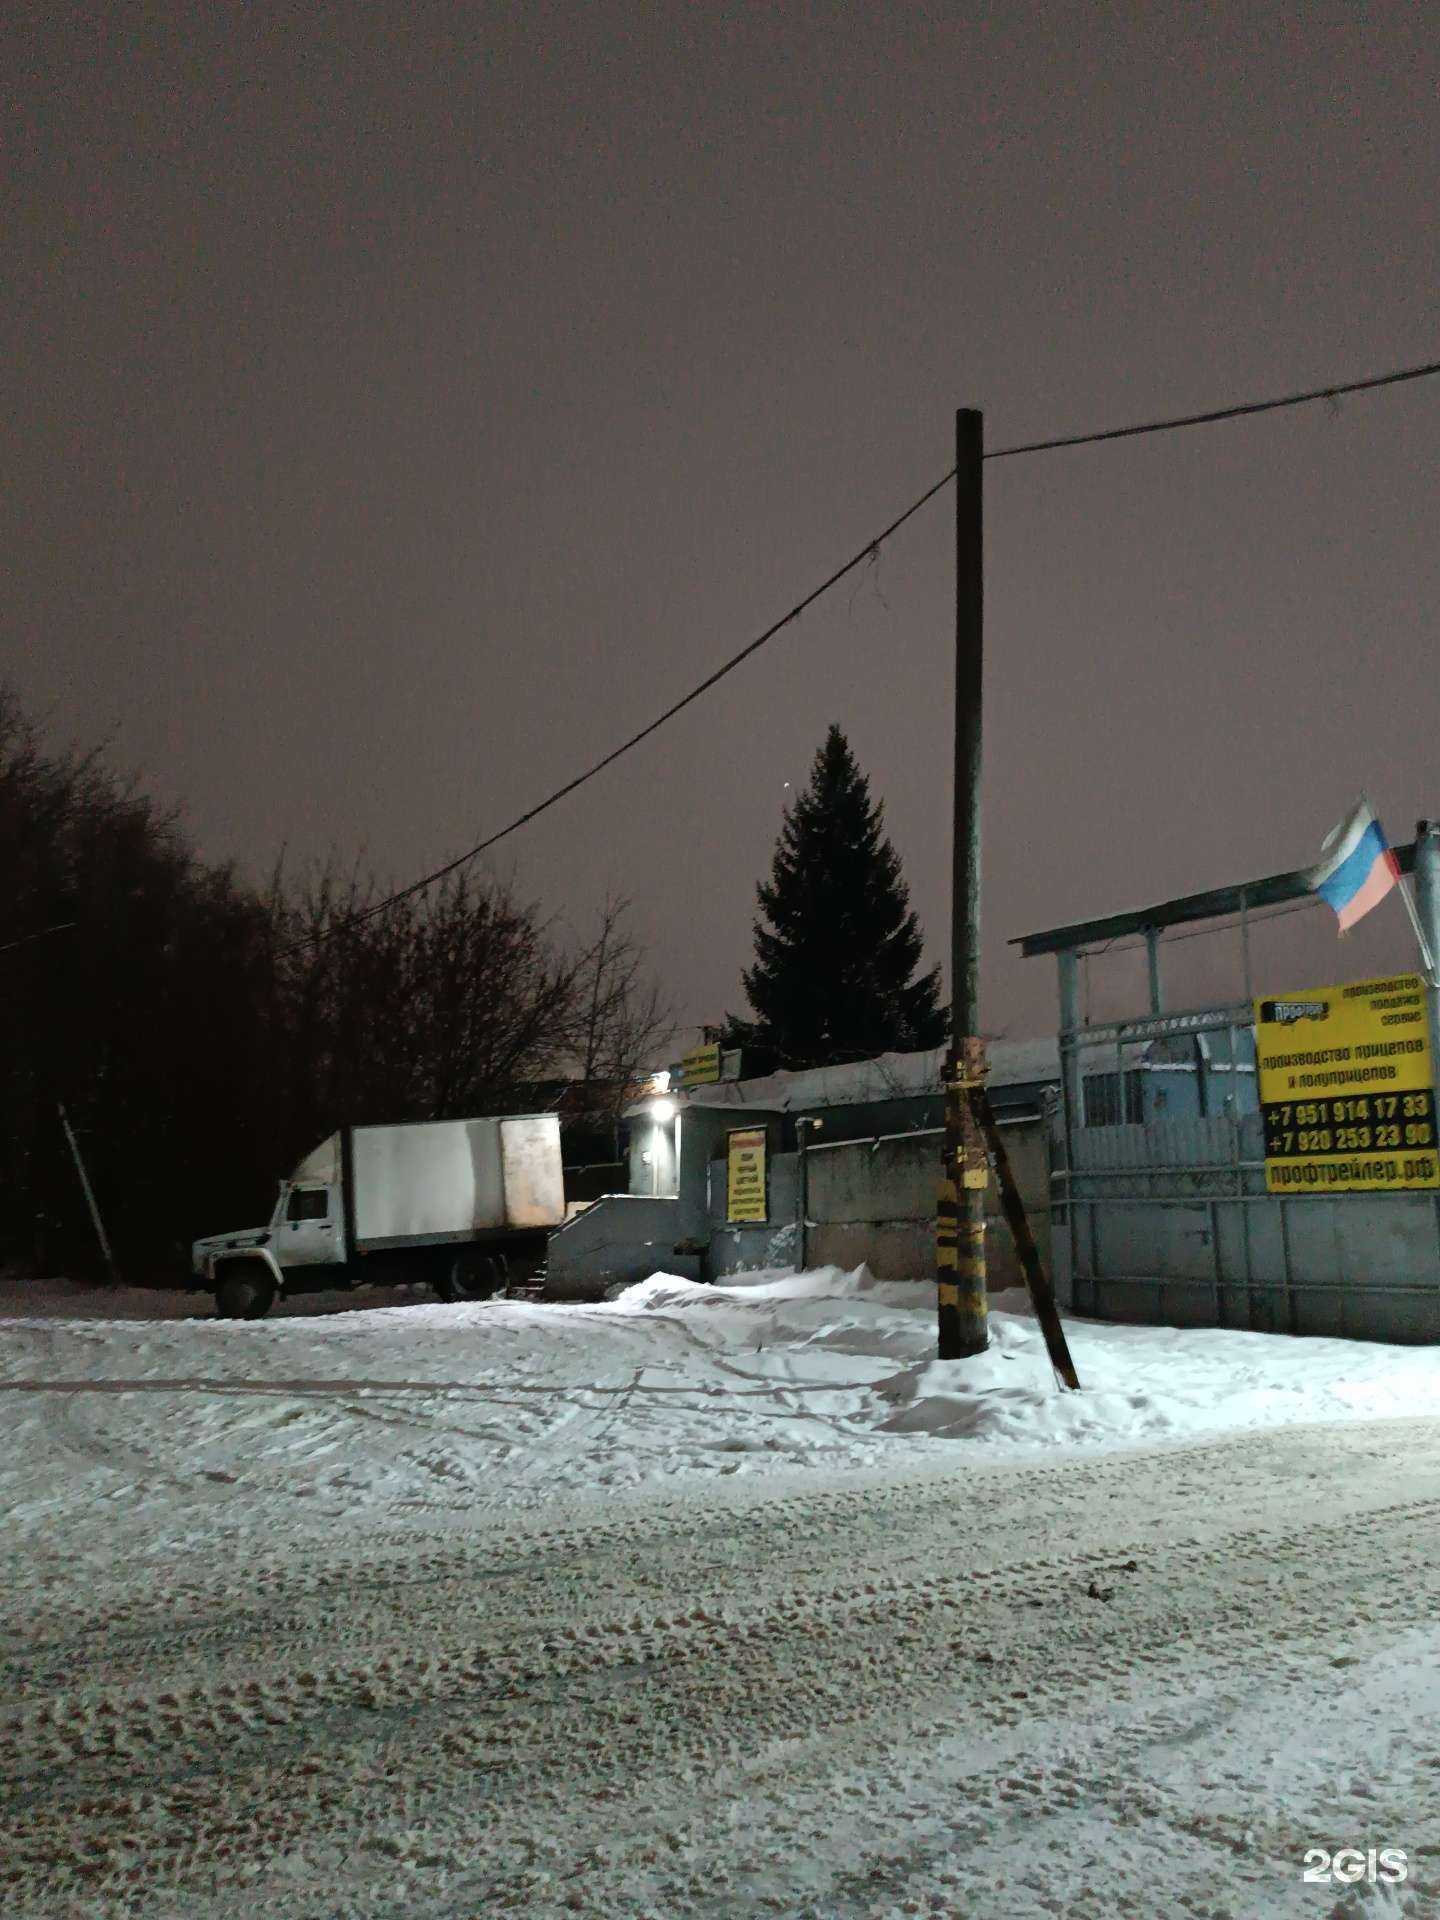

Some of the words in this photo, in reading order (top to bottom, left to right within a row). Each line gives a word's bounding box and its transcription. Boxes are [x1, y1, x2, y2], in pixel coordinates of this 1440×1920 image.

[1263, 1047, 1350, 1070] производство
[1355, 1039, 1424, 1060] прицепов
[1299, 1066, 1397, 1088] полуприцепов
[1268, 1106, 1292, 1127] +7
[1296, 1103, 1329, 1125] 951
[1333, 1100, 1369, 1122] 914
[1374, 1097, 1397, 1119] 17
[1269, 1131, 1294, 1152] +7
[1298, 1129, 1332, 1151] 920
[1336, 1126, 1371, 1149] 253
[1375, 1125, 1400, 1146] 23
[1271, 1156, 1436, 1186] профтрейлер.рф
